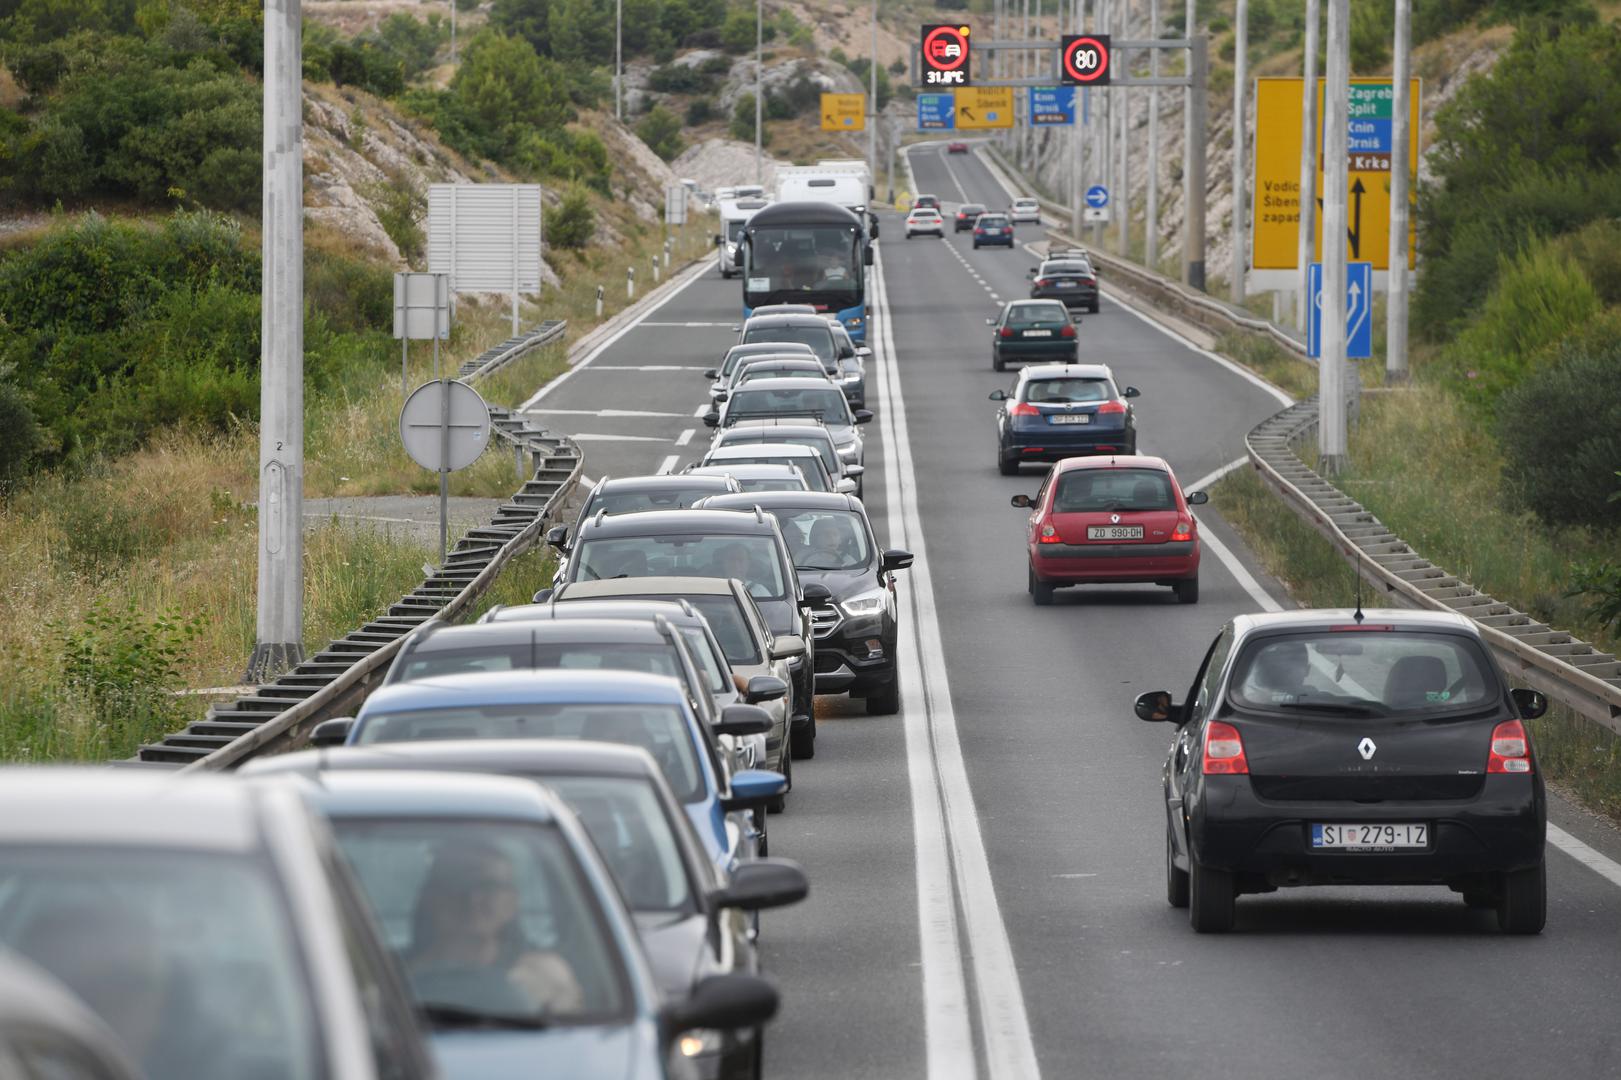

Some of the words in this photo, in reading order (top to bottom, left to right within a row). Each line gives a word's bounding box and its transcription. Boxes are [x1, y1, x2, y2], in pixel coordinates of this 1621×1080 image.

[1075, 50, 1097, 69] 80
[1348, 87, 1393, 102] Zagreb
[1348, 103, 1376, 117] Split
[1355, 156, 1389, 169] Krka
[1264, 181, 1299, 192] Vodic
[1264, 194, 1299, 207] Šiben
[276, 441, 283, 451] 2
[1095, 528, 1106, 538] ZD
[1324, 826, 1343, 845] SI
[1360, 825, 1426, 845] 279-IZ
